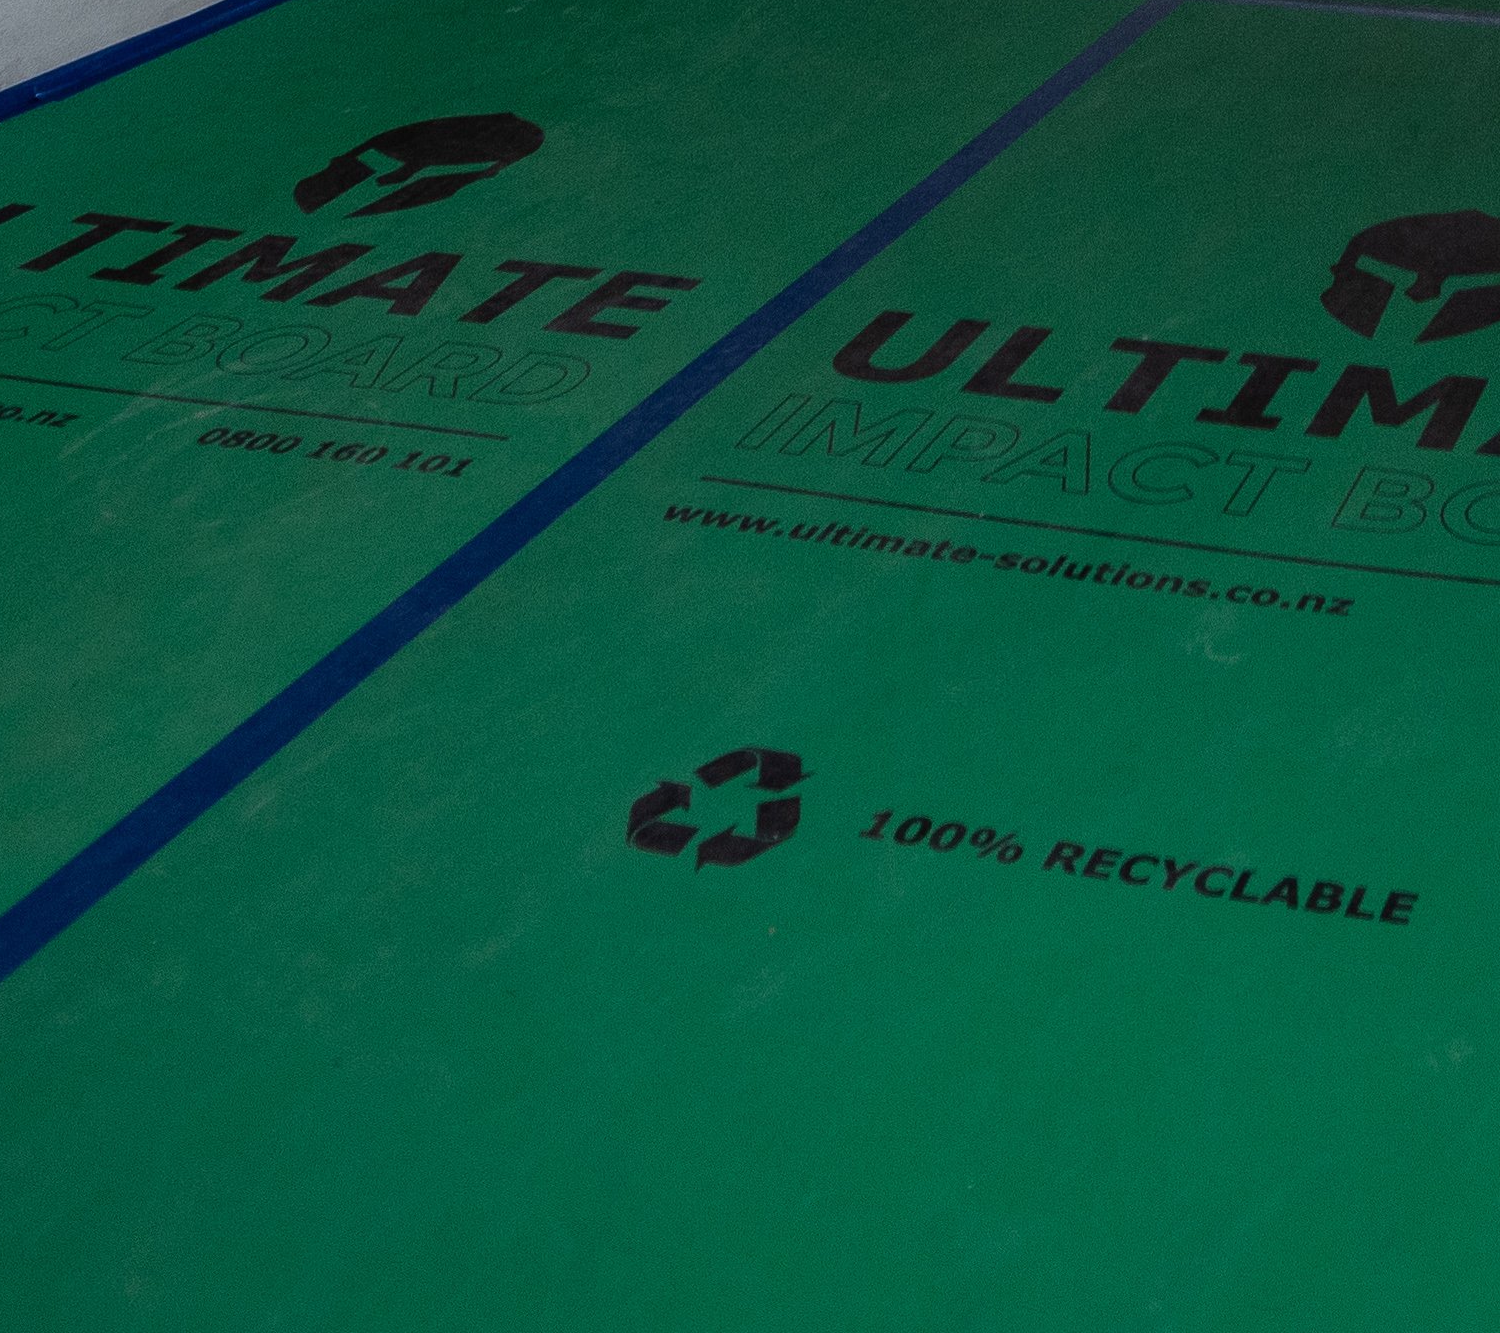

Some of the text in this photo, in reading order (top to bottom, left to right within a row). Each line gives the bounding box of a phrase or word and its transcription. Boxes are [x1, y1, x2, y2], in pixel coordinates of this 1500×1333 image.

[121, 312, 594, 409] BOARD
[195, 423, 476, 480] 0800 160 101
[736, 390, 1312, 517] IMPACT
[661, 499, 1356, 620] www.ultimate-solutions.co.nz
[857, 807, 1419, 928] 100% RECYCLABLE
